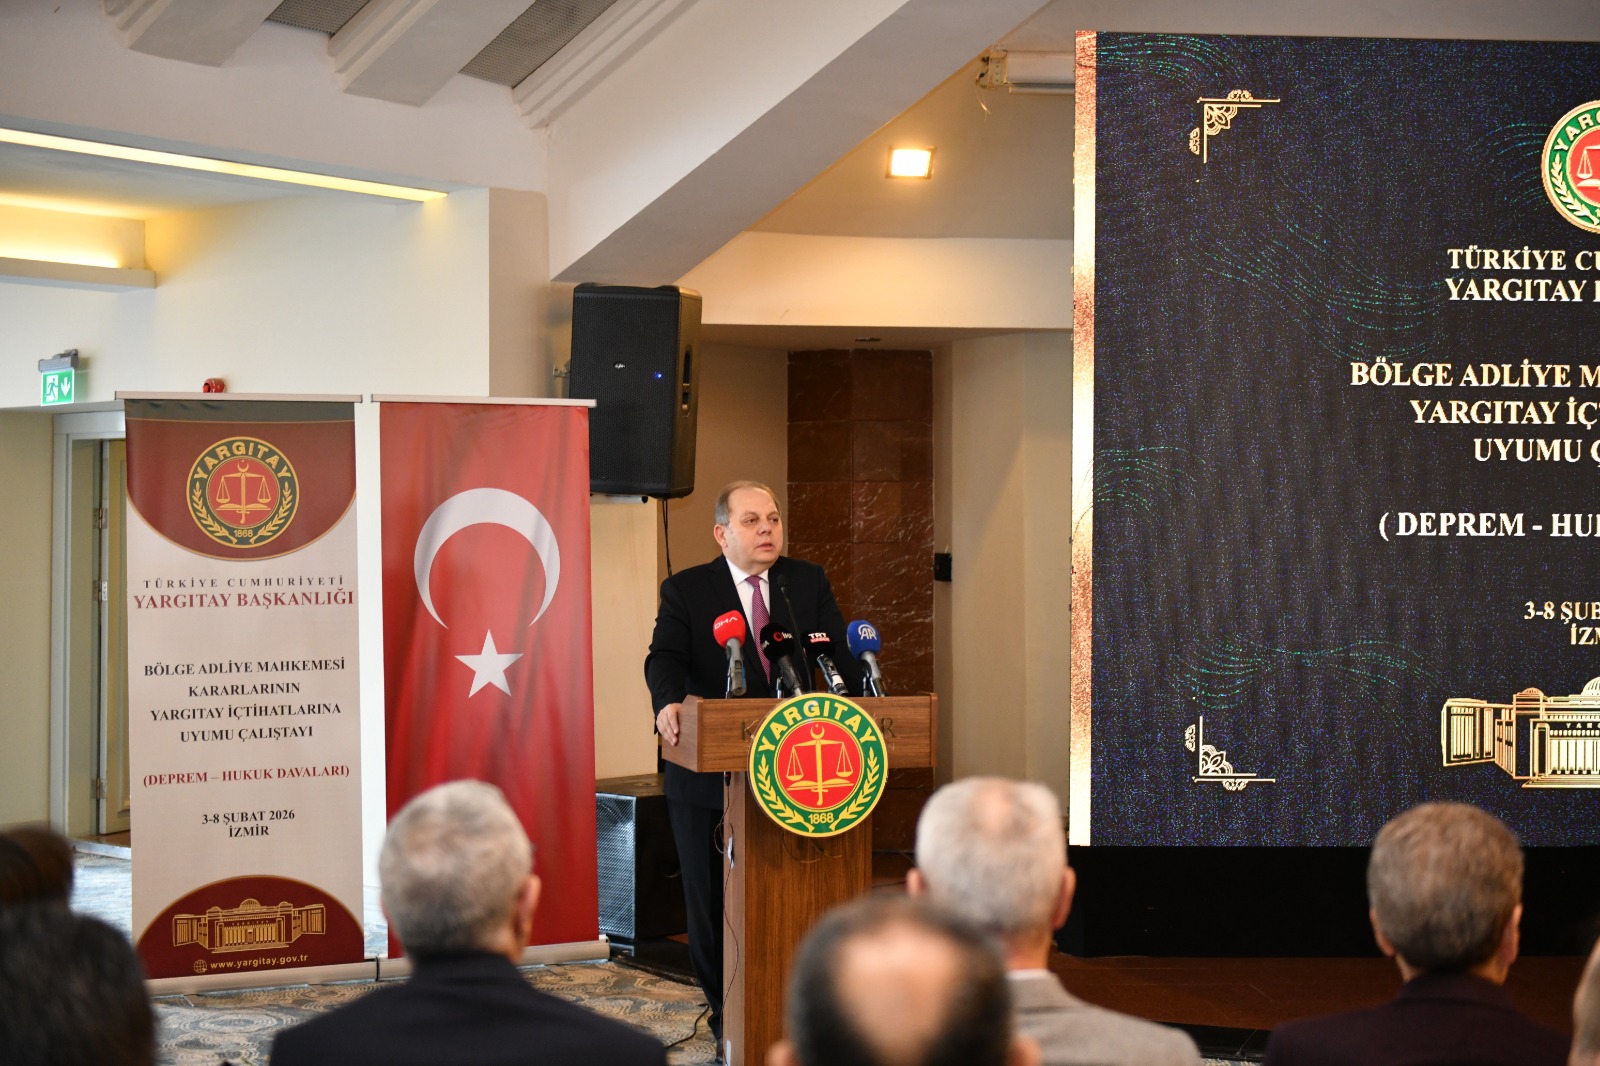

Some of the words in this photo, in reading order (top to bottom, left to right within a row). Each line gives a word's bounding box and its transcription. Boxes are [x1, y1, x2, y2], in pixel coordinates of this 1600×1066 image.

[1447, 245, 1566, 271] TÜRKİYE
[1445, 278, 1587, 302] YARGITAY
[1350, 356, 1453, 387] BÖLGE
[1459, 358, 1571, 388] ADLİYE
[1410, 400, 1560, 425] YARGITAY
[1566, 396, 1600, 430] İÇ
[194, 441, 292, 481] YARGITAY
[1474, 438, 1582, 463] UYUMU
[234, 529, 254, 538] 1868
[1550, 513, 1600, 537] HU
[144, 576, 218, 589] TÜRKİYE
[227, 575, 343, 587] CUMHURİYETİ
[133, 593, 232, 609] YARGITAY
[237, 588, 354, 609] BAŞKANLIĞI
[1524, 601, 1555, 620] 3-8
[860, 627, 877, 640] AA
[1571, 623, 1600, 645] İZ
[144, 662, 195, 677] BÖLGE
[199, 660, 253, 674] ADLİYE
[257, 656, 345, 672] MAHKEMESİ
[188, 682, 300, 697] KARARLARININ
[150, 707, 224, 721] YARGITAY
[228, 703, 341, 720] İÇTİHATLARINA
[180, 729, 234, 742] UYUMU
[238, 726, 313, 742] ÇALIŞTAYI
[758, 700, 877, 752] YARGITAY
[143, 772, 208, 788] (DEPREM
[222, 768, 273, 782] HUKUK
[277, 765, 350, 779] DAVALARI)
[202, 813, 220, 825] 3-8
[223, 811, 265, 825] ŞUBAT
[269, 809, 295, 820] 2026
[808, 812, 834, 824] 1868
[229, 825, 270, 838] İZMİR
[210, 953, 308, 969] www.yargitay.gov.tr
